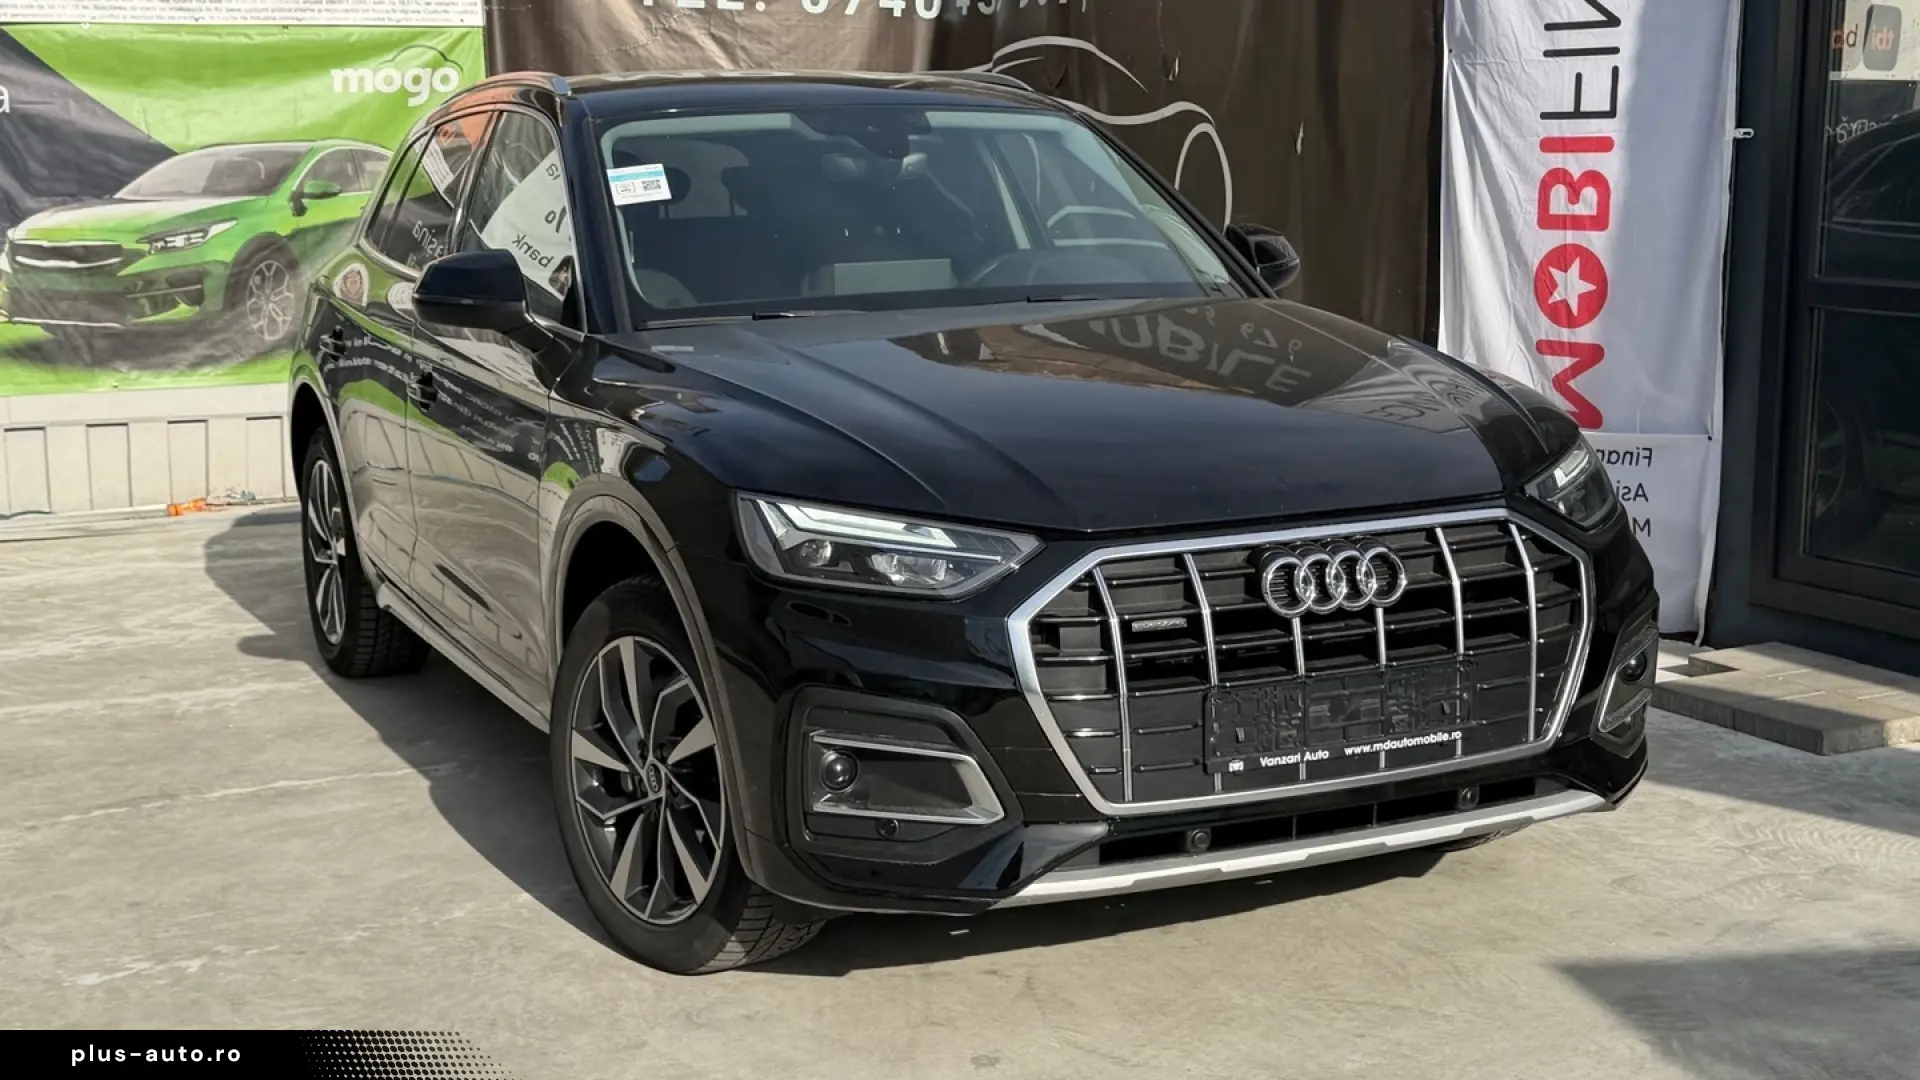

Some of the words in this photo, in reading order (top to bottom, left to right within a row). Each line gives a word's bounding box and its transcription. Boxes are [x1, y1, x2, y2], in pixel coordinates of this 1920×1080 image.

[330, 67, 460, 107] mogo
[1303, 749, 1330, 763] Auto
[1343, 730, 1463, 757] www.mdautomobile.ro
